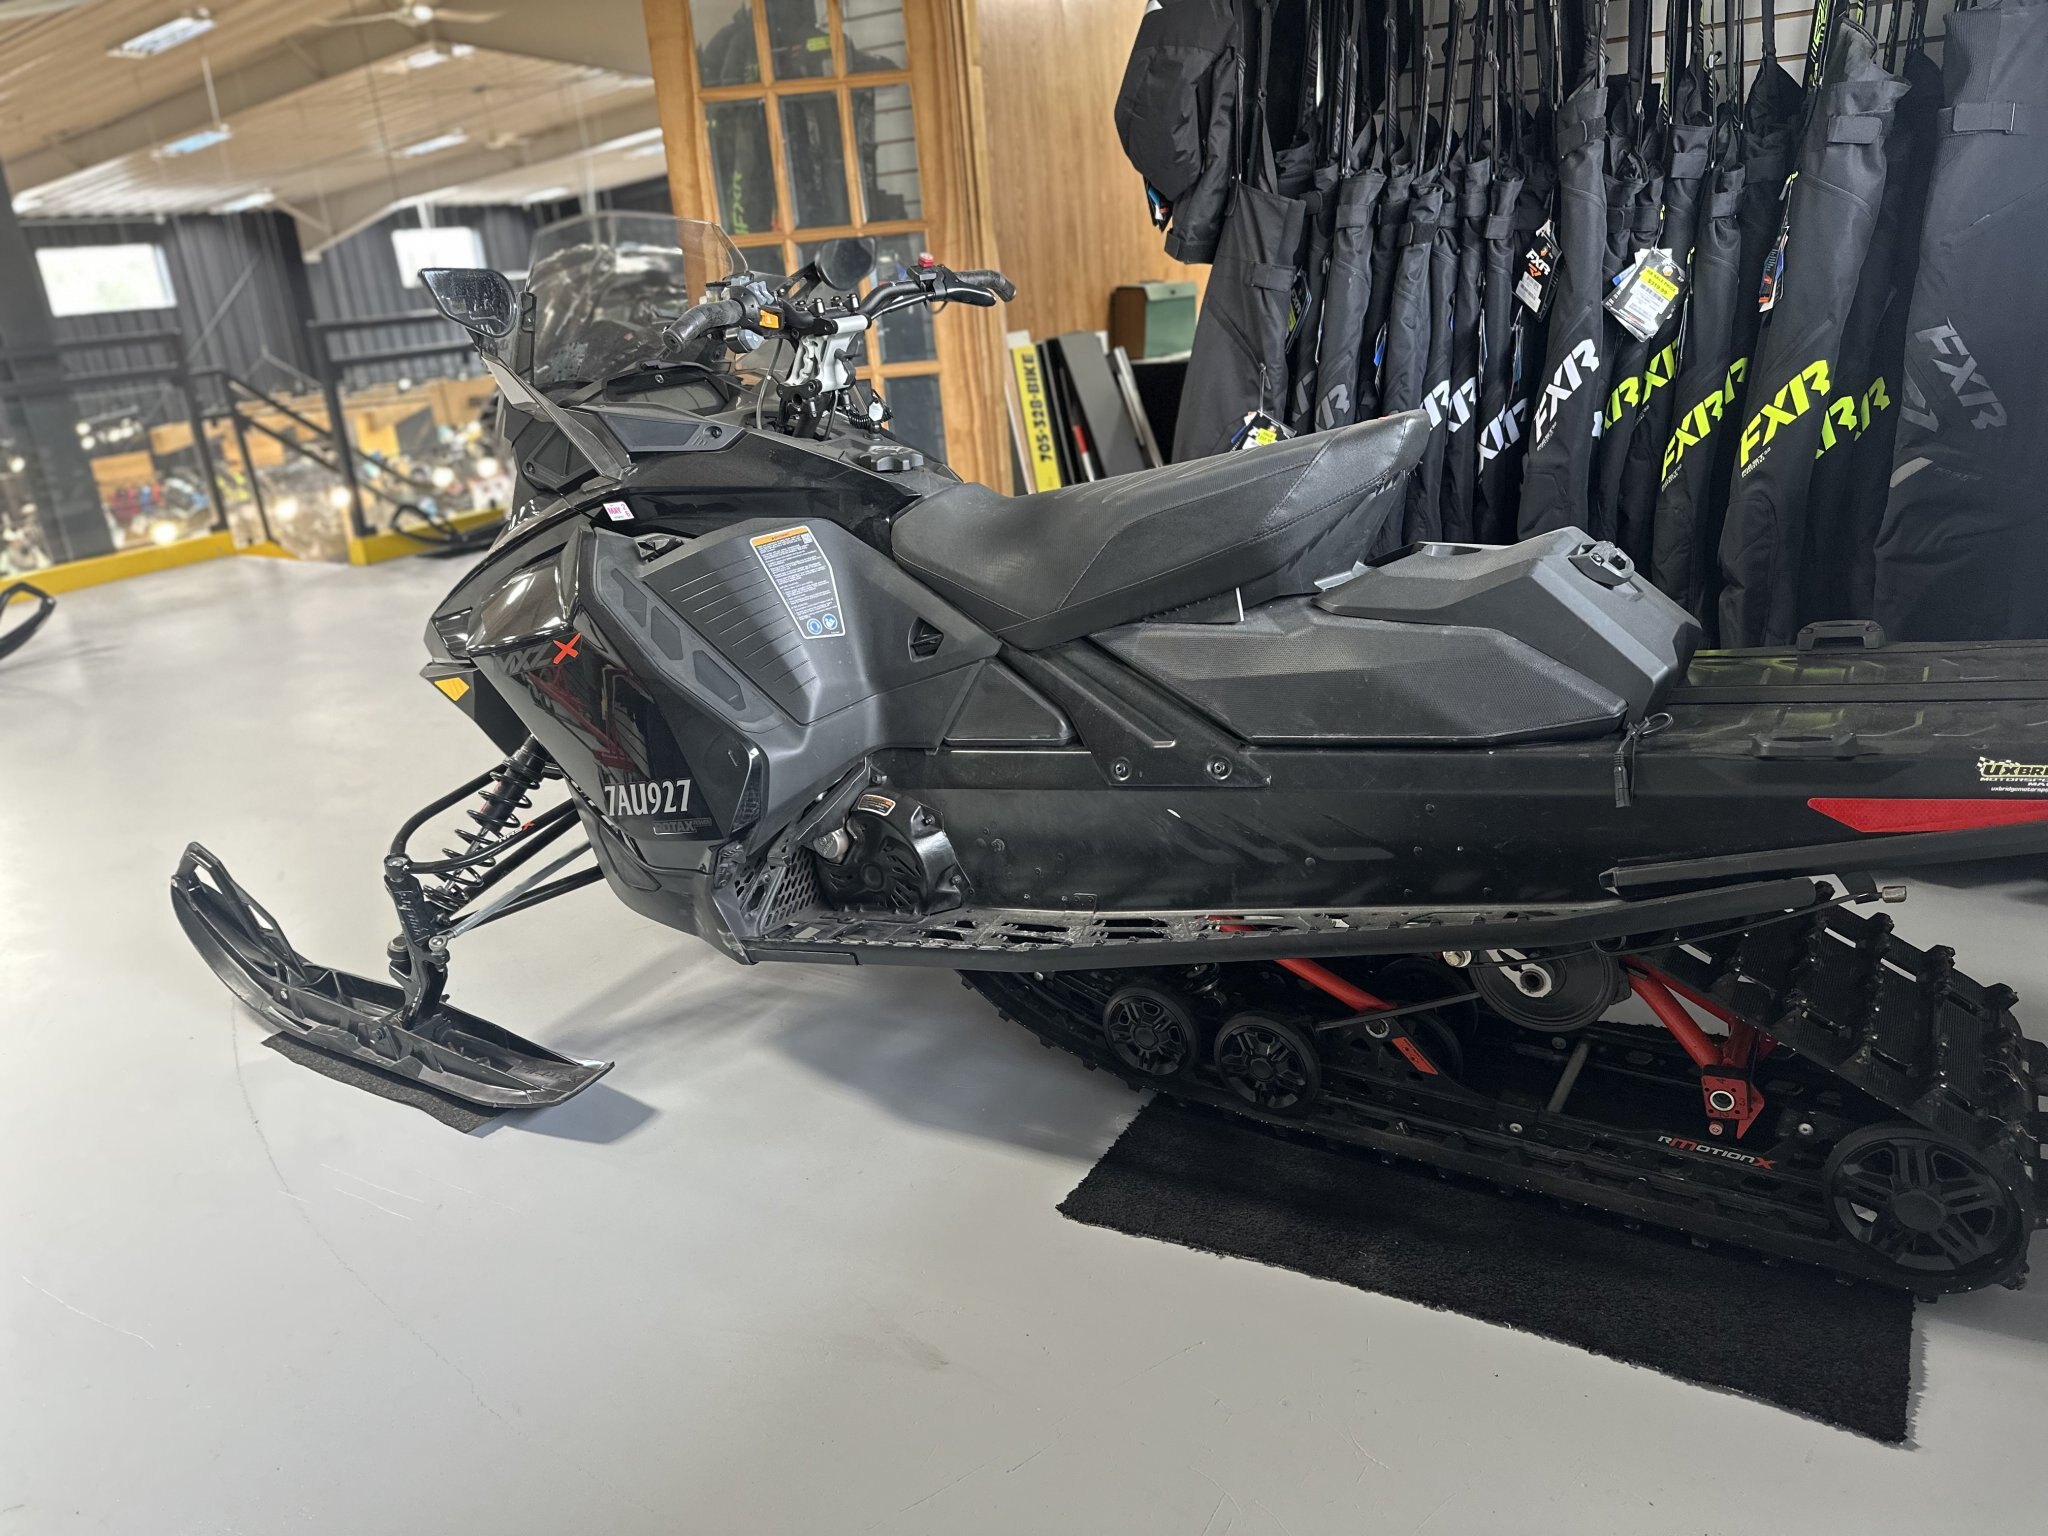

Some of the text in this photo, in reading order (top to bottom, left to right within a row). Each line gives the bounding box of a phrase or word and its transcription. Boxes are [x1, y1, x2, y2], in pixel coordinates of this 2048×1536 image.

[1525, 248, 1551, 276] FXR
[1533, 338, 1600, 444] FXR
[1741, 359, 1831, 468] FXR
[1914, 316, 2009, 430] FXR
[1661, 389, 1723, 482] FXR
[604, 779, 691, 817] 7AU927
[654, 820, 695, 833] ROTAX
